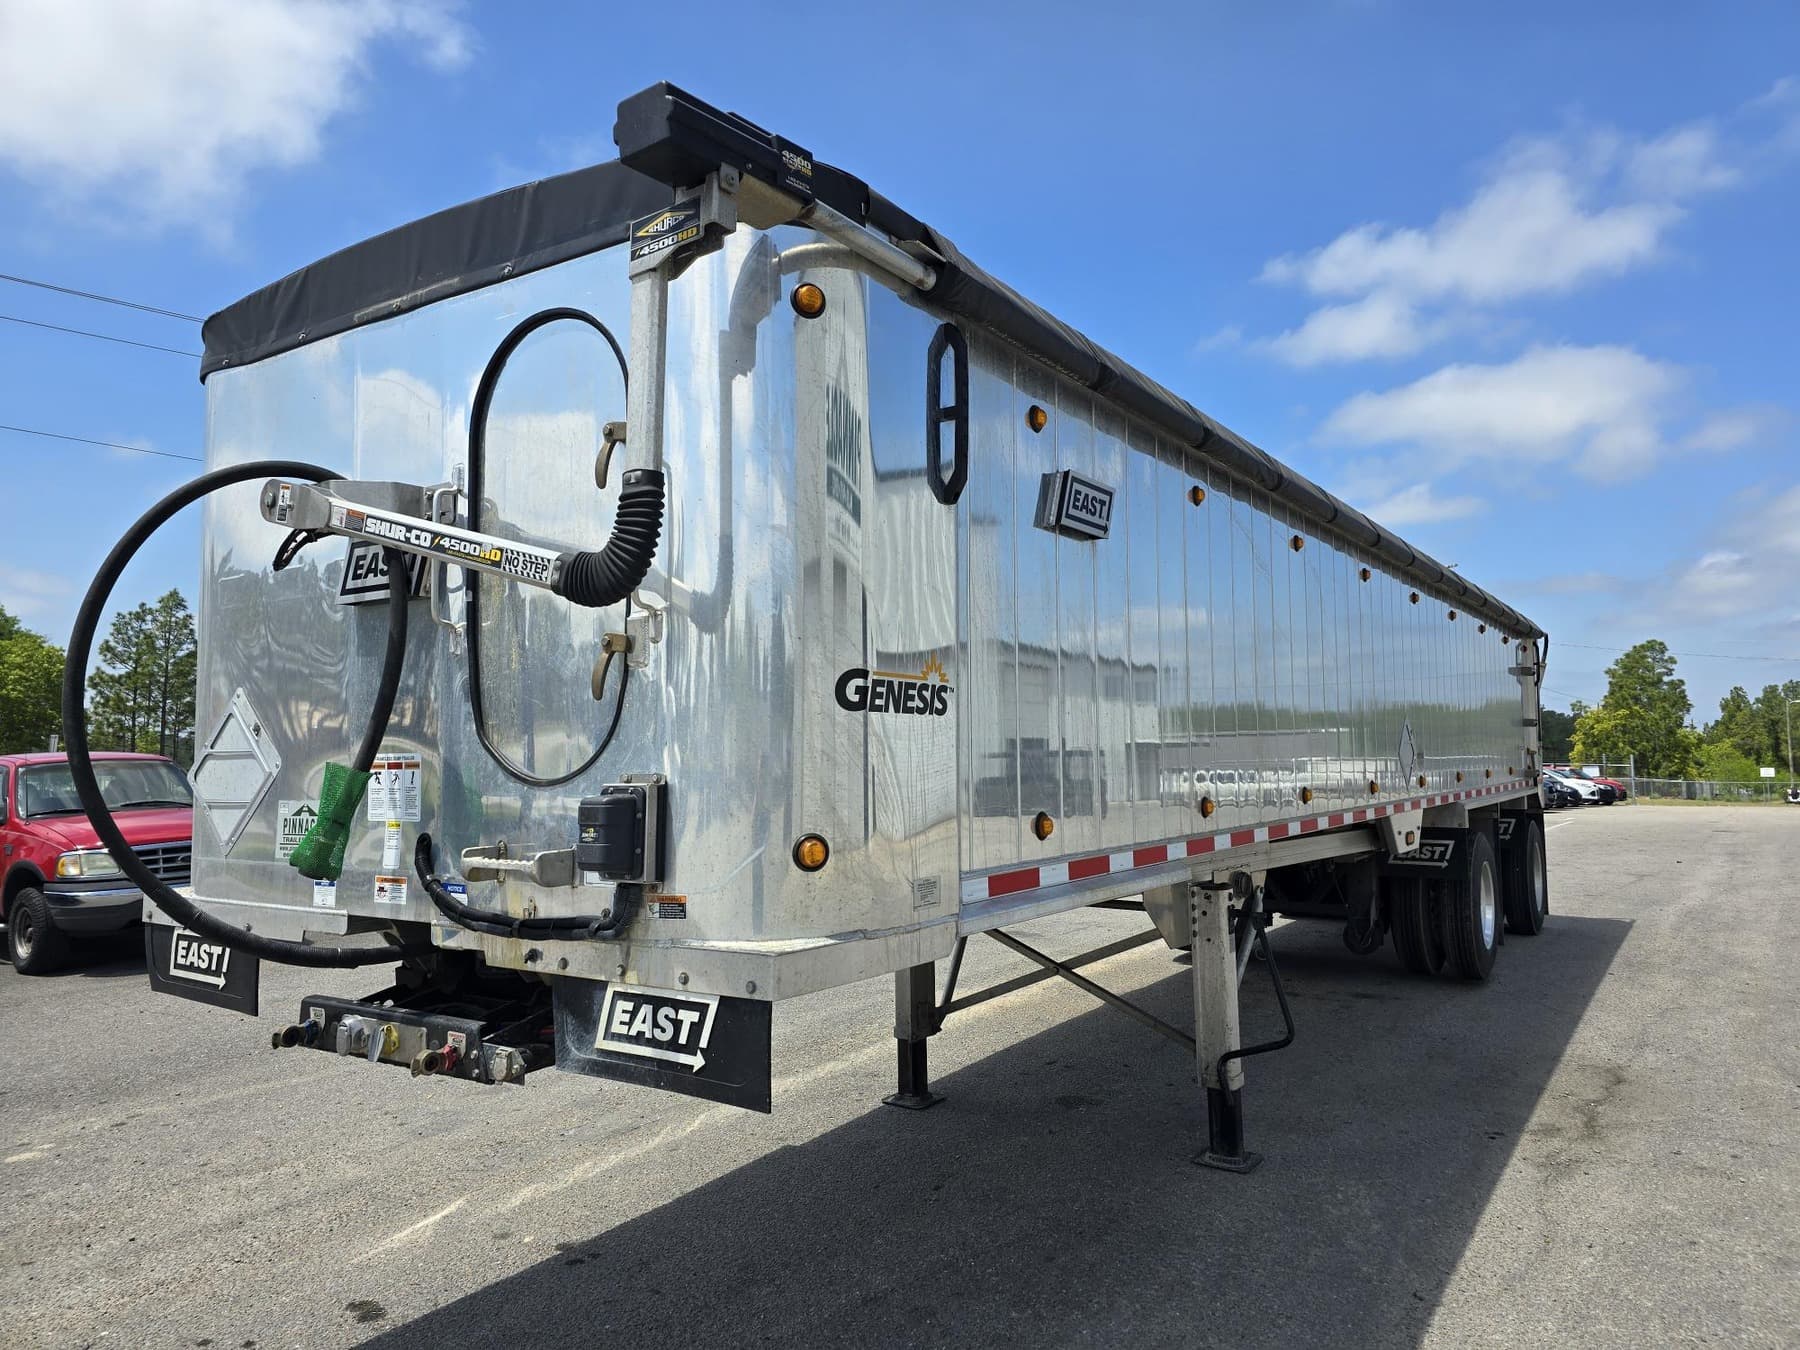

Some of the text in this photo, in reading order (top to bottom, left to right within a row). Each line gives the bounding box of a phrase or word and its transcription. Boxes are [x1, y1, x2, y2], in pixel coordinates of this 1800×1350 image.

[639, 226, 698, 256] 4500HD
[1072, 489, 1106, 519] EAST
[365, 518, 432, 547] SHUR-CO
[352, 551, 390, 580] EAS
[504, 555, 520, 569] NO
[521, 560, 548, 575] STEP
[835, 668, 948, 716] GENESIS
[283, 817, 316, 834] PINNAC
[1397, 845, 1447, 859] AST
[176, 940, 223, 971] EAST
[610, 1000, 700, 1045] EAST
